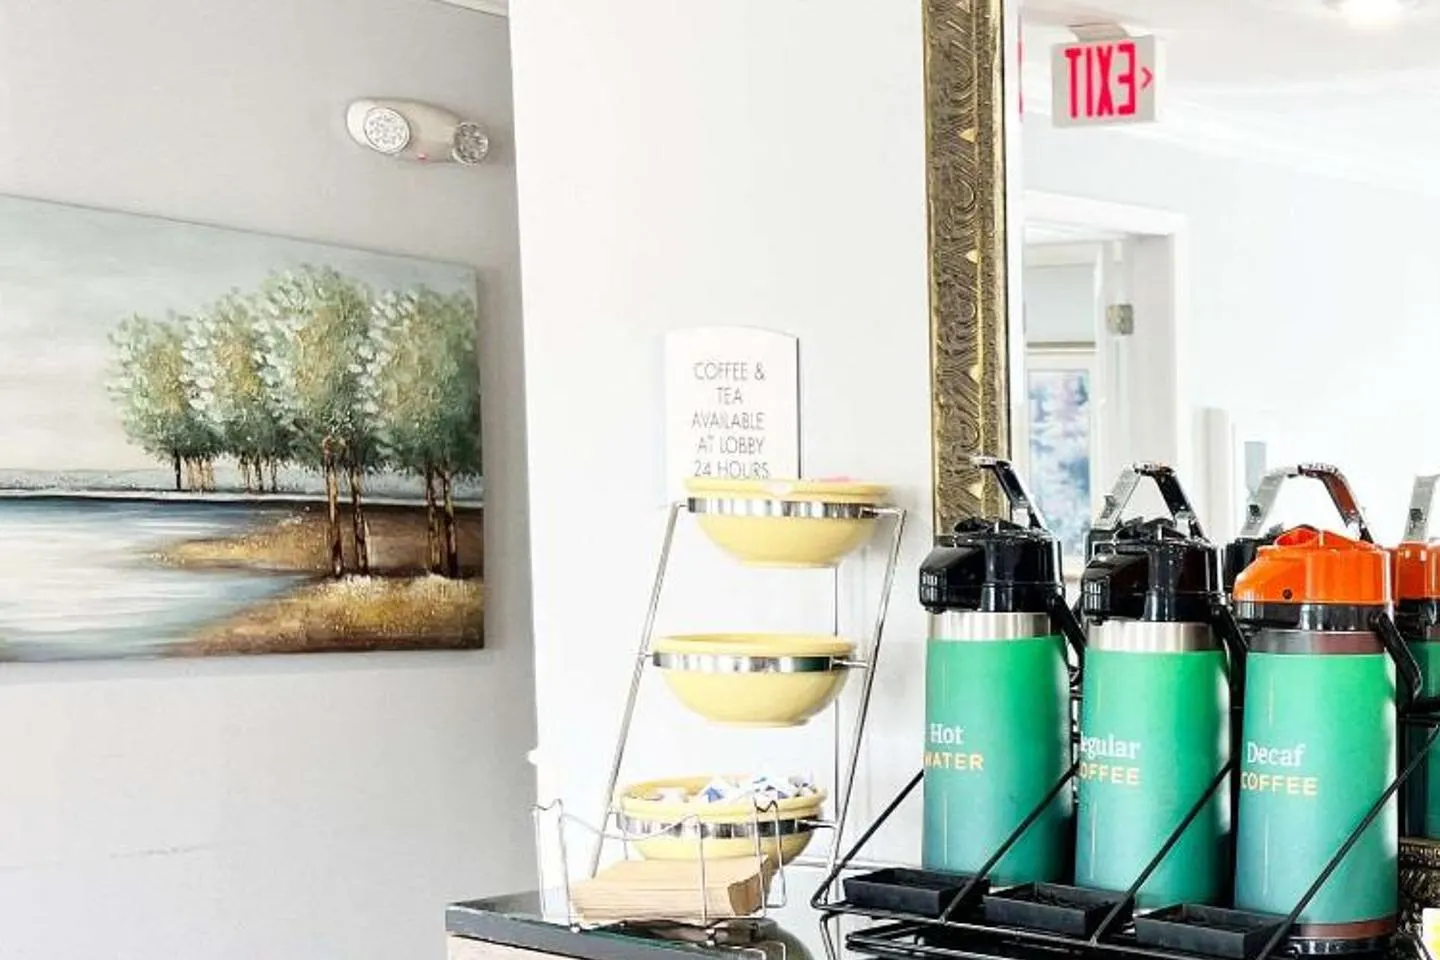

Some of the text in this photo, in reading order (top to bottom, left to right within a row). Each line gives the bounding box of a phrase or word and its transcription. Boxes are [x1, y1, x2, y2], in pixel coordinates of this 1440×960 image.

[692, 361, 766, 381] COFFEE &
[716, 386, 743, 405] TEA
[691, 411, 765, 430] AVAILABLE
[697, 434, 765, 454] AT LOBBY
[693, 459, 769, 480] 24 HOURS
[930, 723, 965, 746] Hot
[1079, 731, 1141, 760] egular
[1247, 741, 1306, 767] Decaf
[1079, 761, 1140, 785] OFFEE
[1241, 771, 1318, 796] COFFEE
